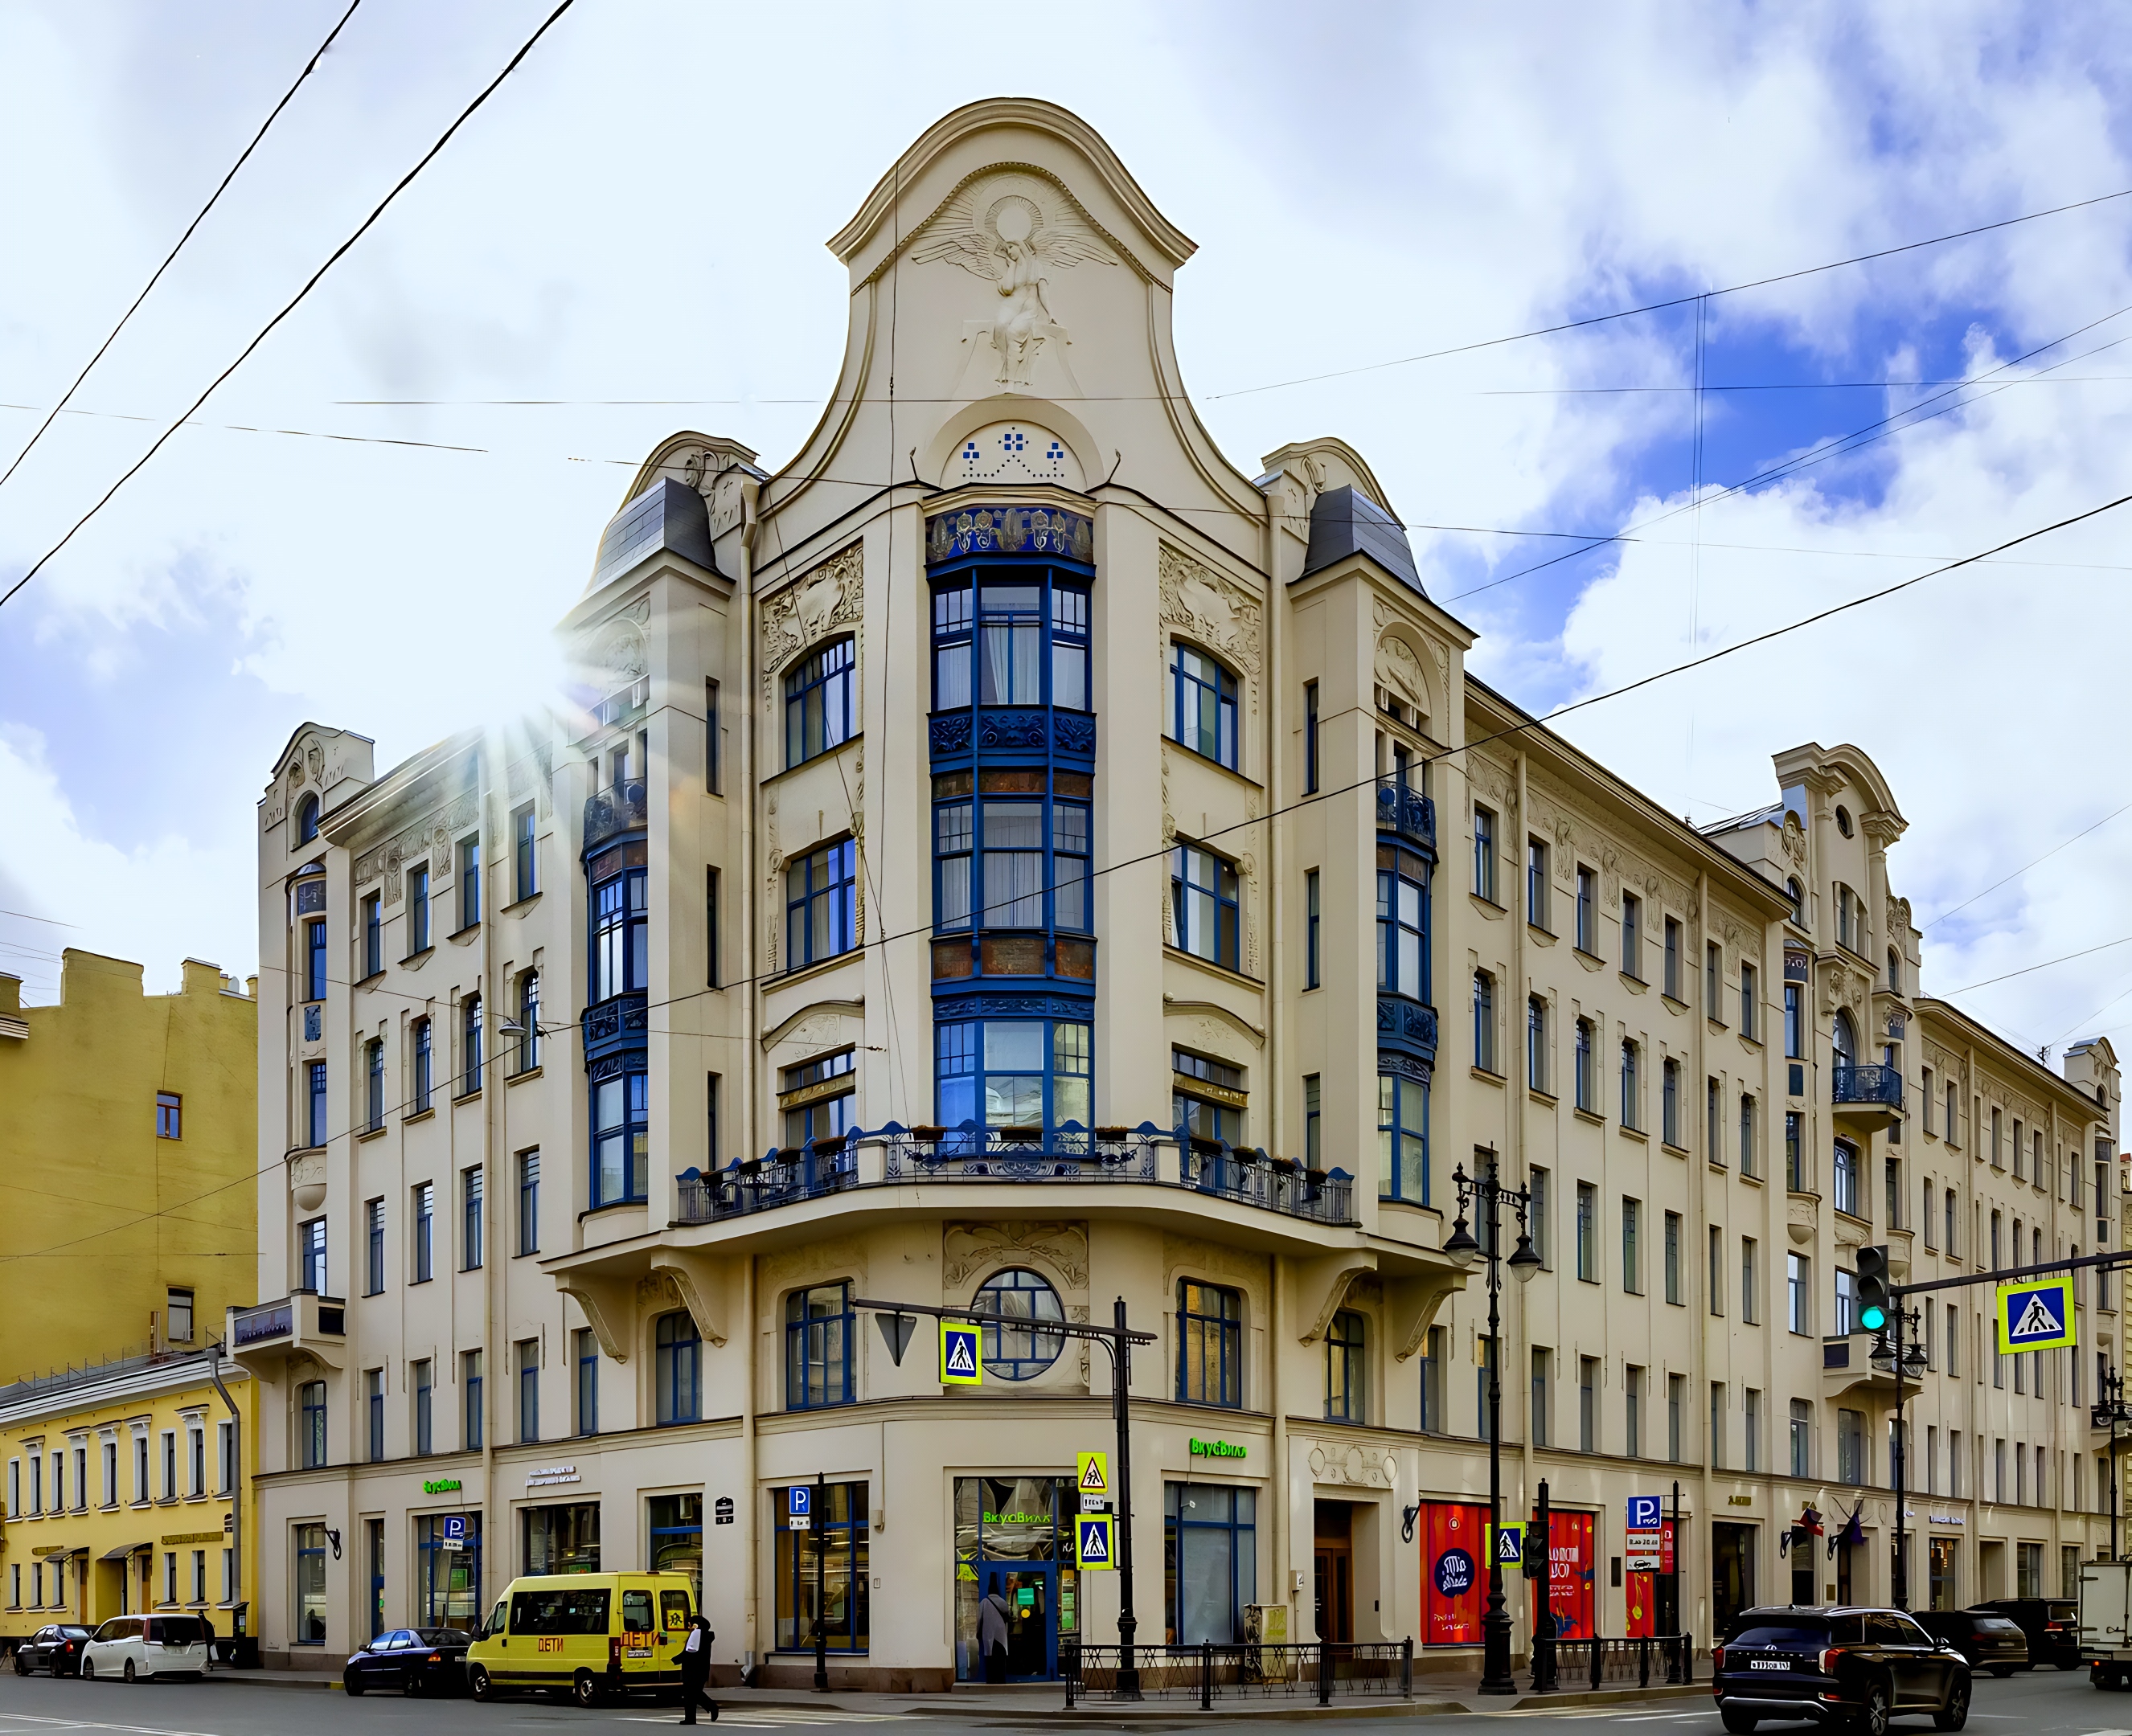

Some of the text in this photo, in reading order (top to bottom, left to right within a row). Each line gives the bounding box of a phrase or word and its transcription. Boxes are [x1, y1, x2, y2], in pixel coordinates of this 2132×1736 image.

[795, 1490, 806, 1511] P
[1636, 1500, 1654, 1525] P
[449, 1519, 461, 1537] P
[538, 1637, 564, 1652] ДЕТИ
[620, 1632, 660, 1648] ДЕТИ
